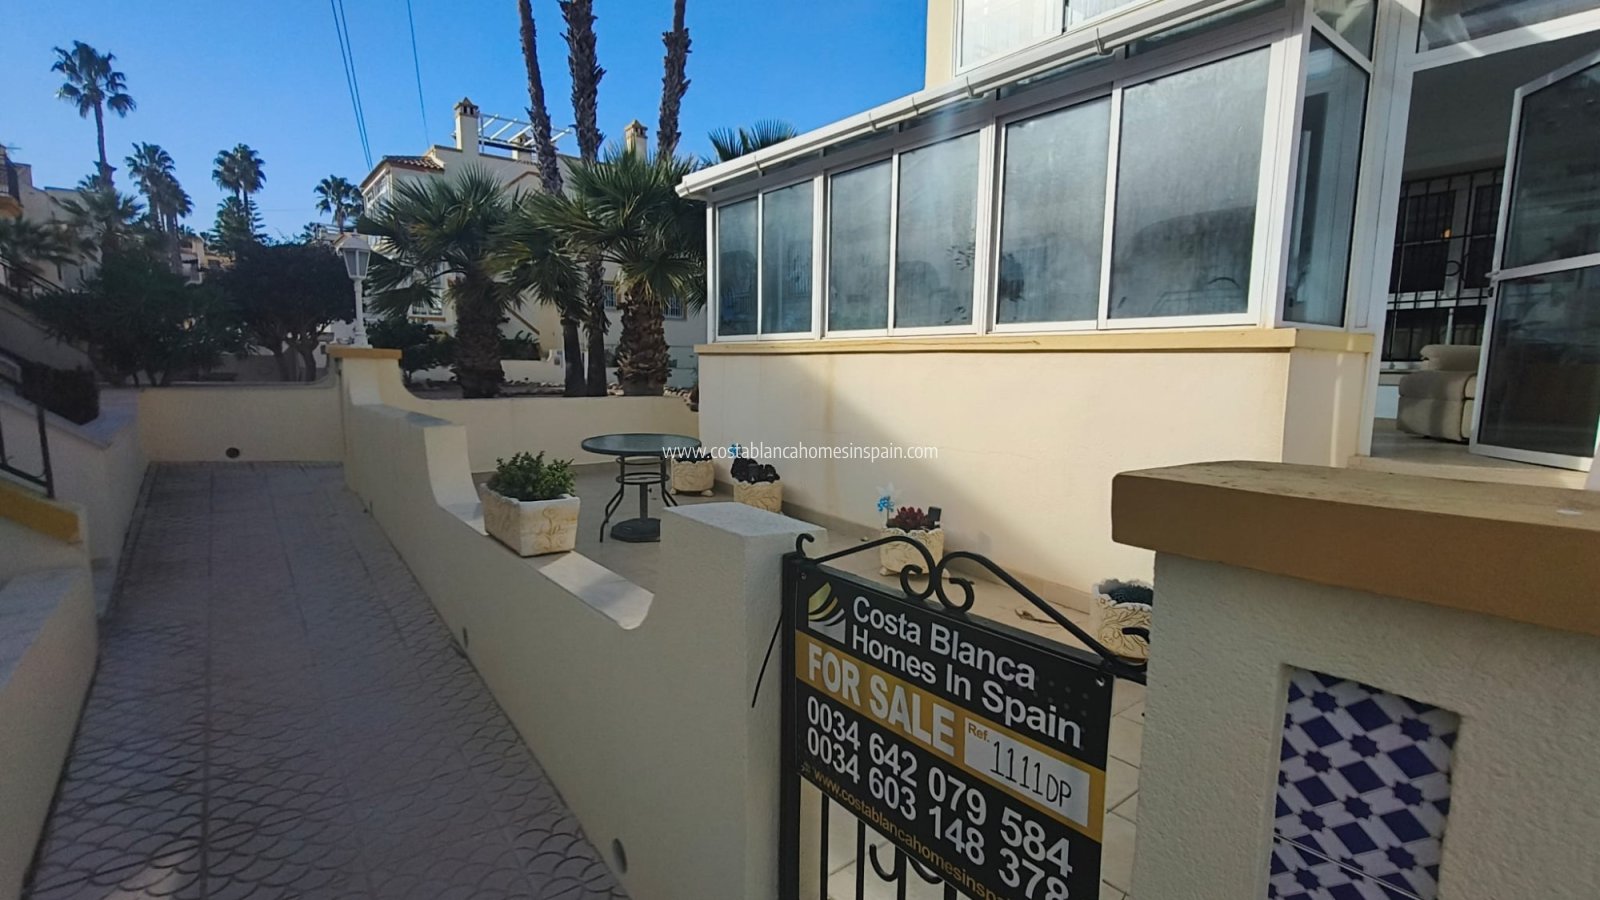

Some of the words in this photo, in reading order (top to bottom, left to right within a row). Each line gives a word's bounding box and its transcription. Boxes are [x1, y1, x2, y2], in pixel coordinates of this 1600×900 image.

[852, 625, 937, 684] Homes
[946, 664, 971, 701] In
[982, 680, 1081, 749] Spain
[853, 595, 921, 645] Costa
[930, 622, 1035, 690] Blanca
[808, 643, 861, 707] FOR
[869, 675, 955, 757] SALE
[968, 723, 990, 743] Ref.
[807, 696, 861, 752] 0034
[869, 732, 918, 788] 642
[928, 767, 987, 826] 079
[1000, 806, 1073, 878] 584
[807, 727, 861, 784] 0034
[868, 766, 917, 821] 603
[928, 808, 985, 866] 148
[998, 847, 1070, 900] 378
[990, 741, 1072, 808] 1111DP
